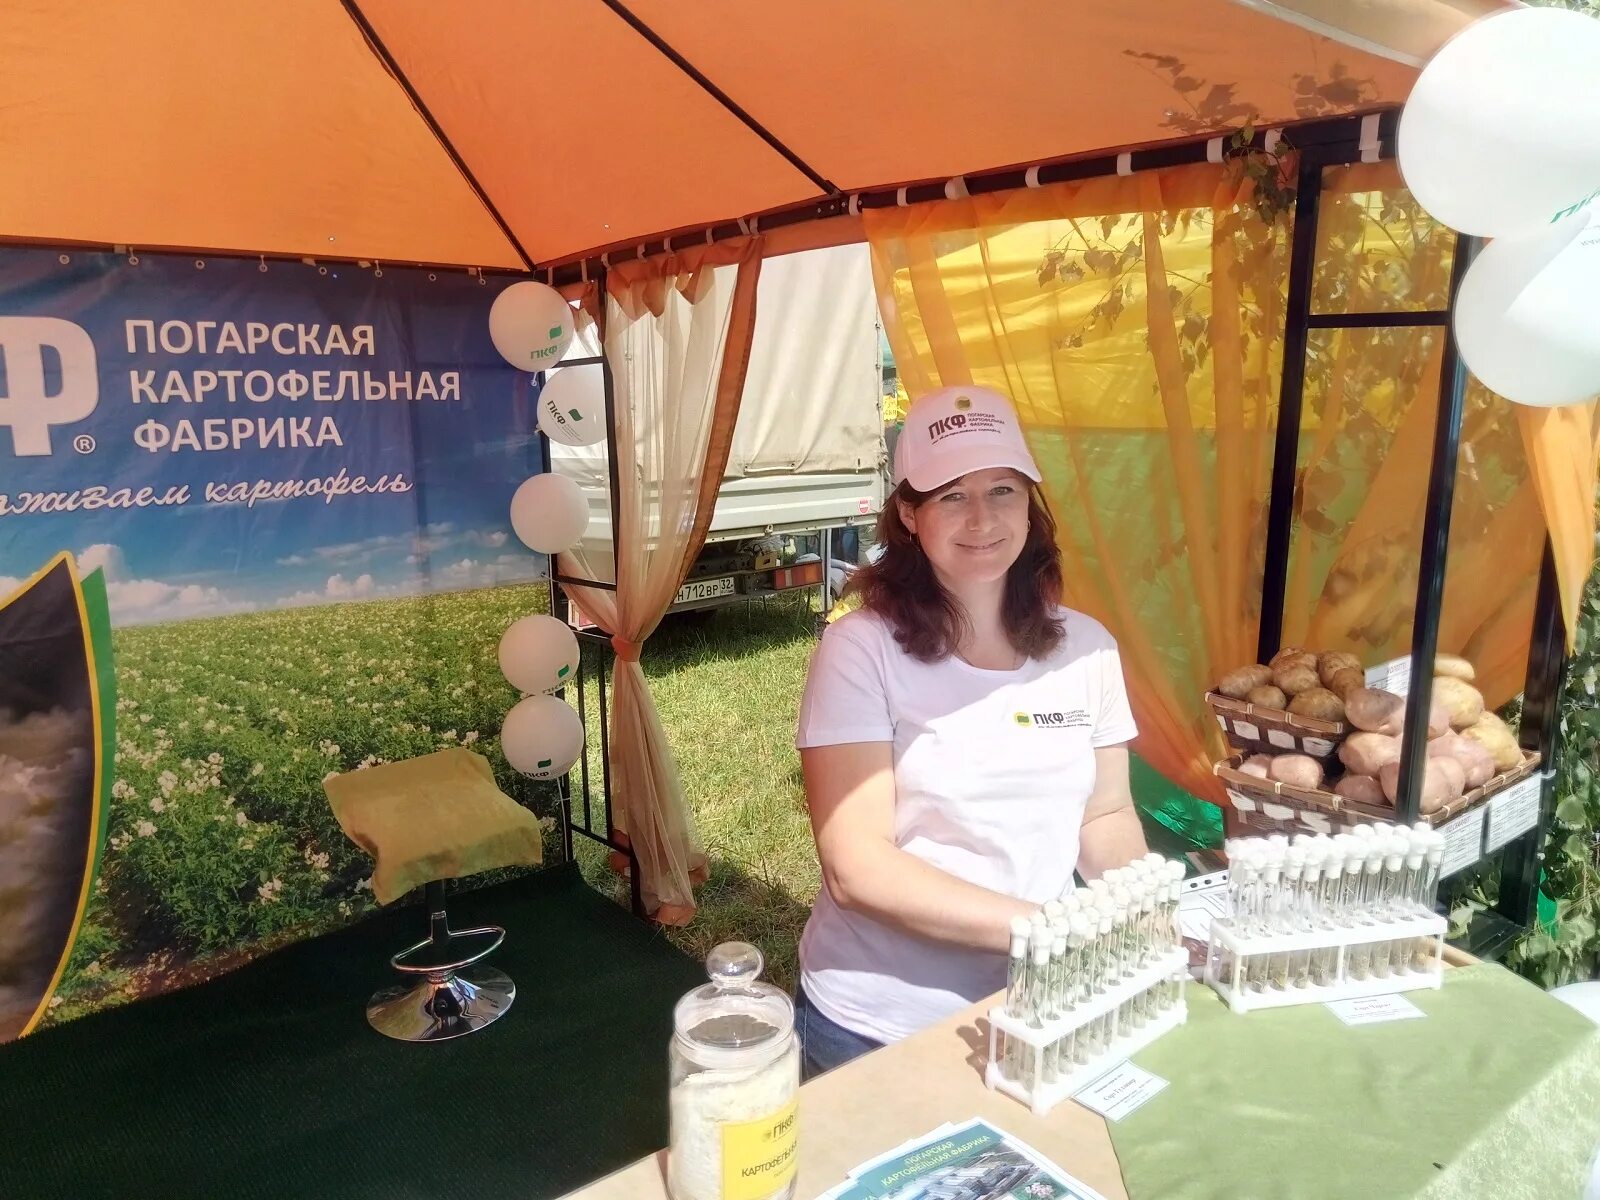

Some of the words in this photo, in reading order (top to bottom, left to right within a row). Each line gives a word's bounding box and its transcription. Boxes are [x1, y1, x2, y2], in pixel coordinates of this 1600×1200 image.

[125, 319, 376, 356] ПОГАРСКАЯ
[530, 345, 559, 360] ПКФ
[130, 369, 461, 403] КАРТОФЕЛЬНАЯ
[547, 400, 566, 425] ПКФ
[134, 416, 344, 452] ФАБРИКА
[928, 414, 967, 440] ПКФ
[206, 467, 414, 508] картофель
[677, 584, 719, 601] Н712ВР
[721, 579, 732, 590] 32
[1033, 712, 1065, 725] ПКФ
[881, 1152, 951, 1186] КАРТОФЕЛЬНАЯ
[950, 1135, 990, 1156] ФАБРИКА
[904, 1141, 955, 1167] ПОГАРСКАЯ
